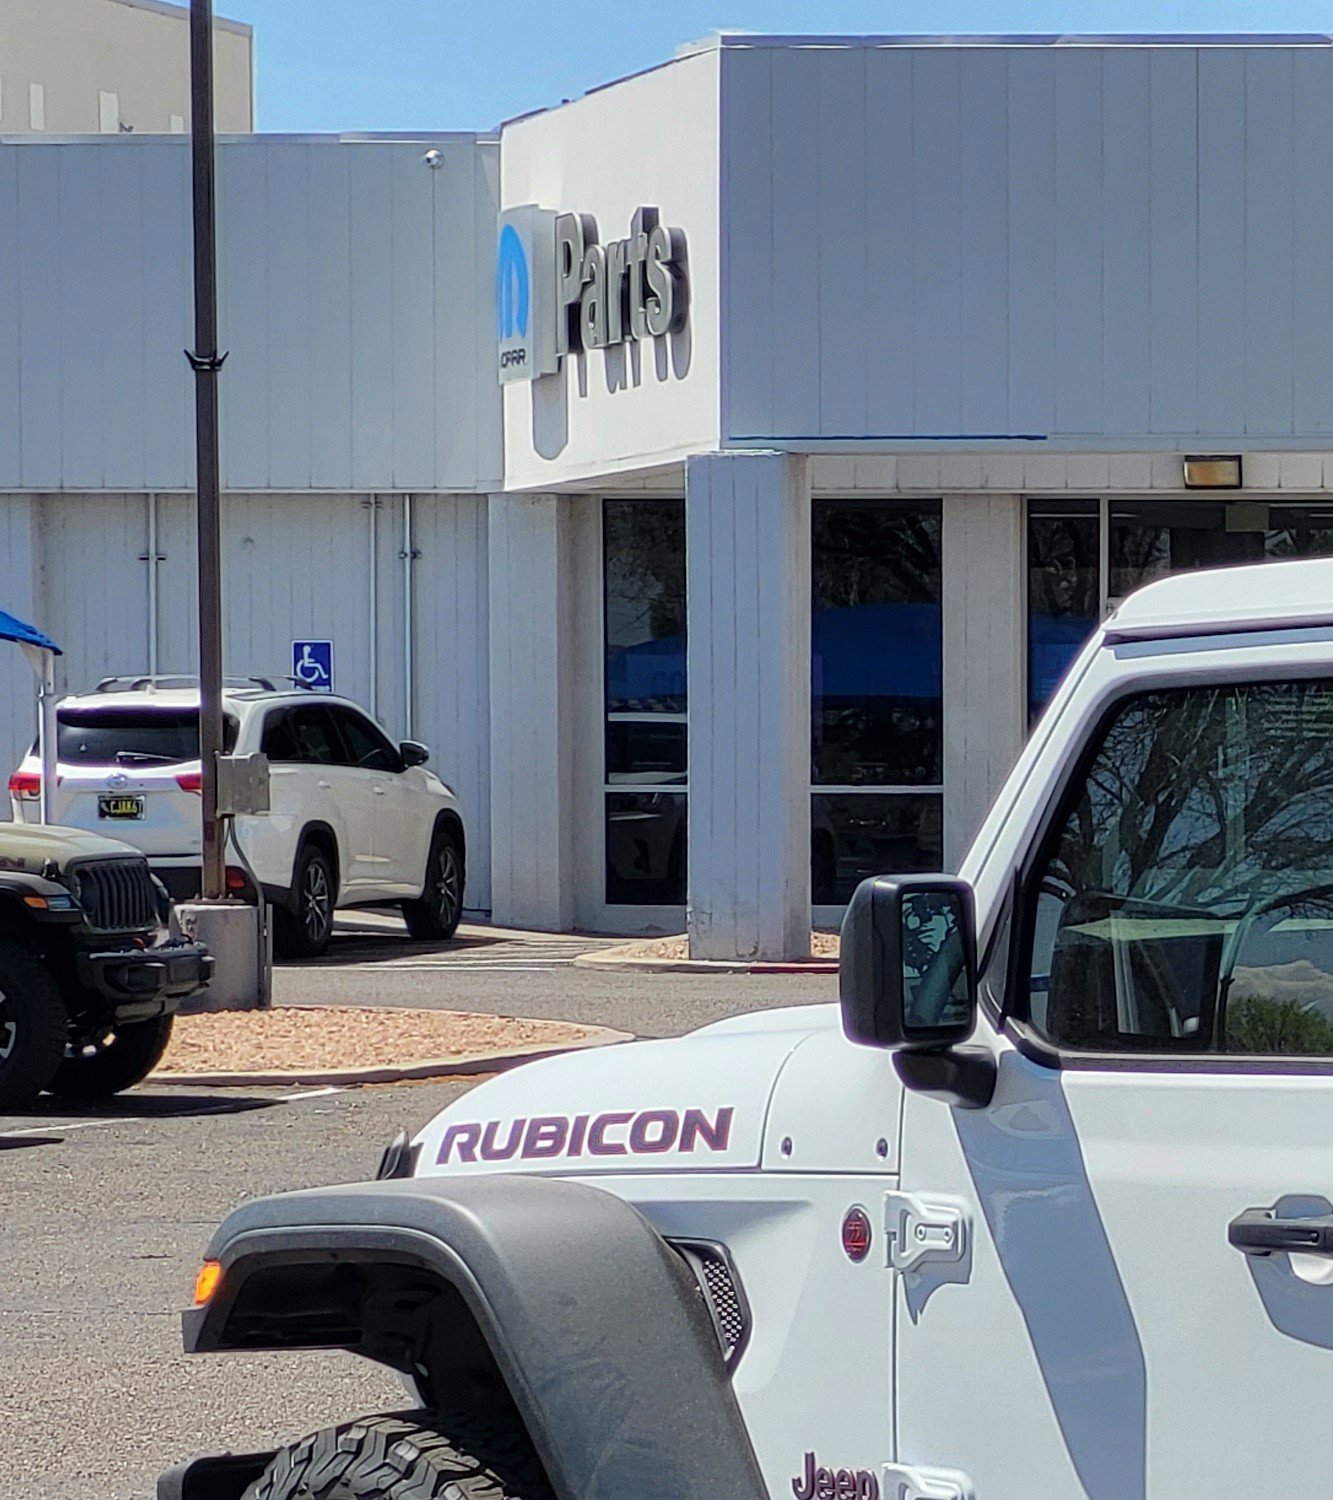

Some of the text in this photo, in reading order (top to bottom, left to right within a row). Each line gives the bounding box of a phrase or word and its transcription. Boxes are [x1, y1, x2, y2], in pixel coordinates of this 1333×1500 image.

[555, 207, 688, 357] Parts
[500, 348, 526, 368] OPAR
[435, 1106, 735, 1165] RUBICON
